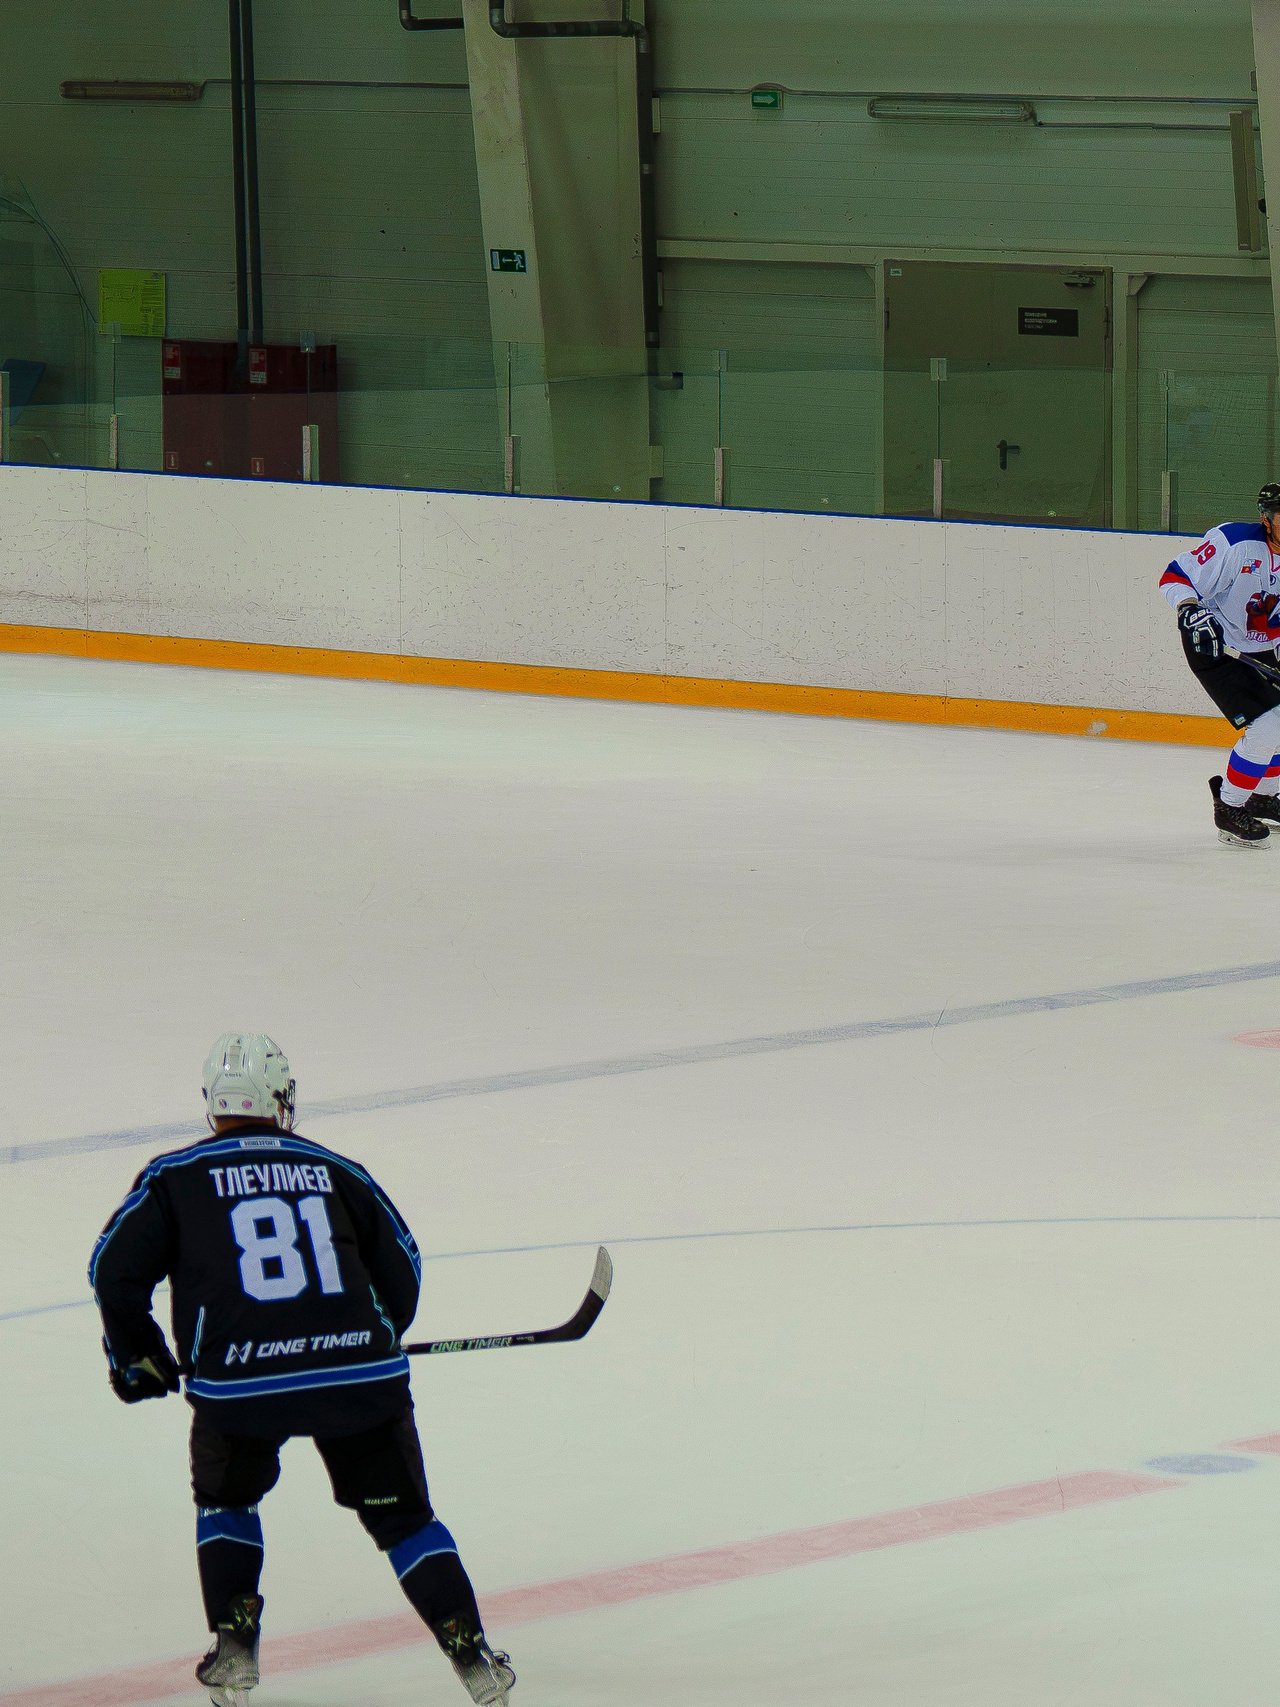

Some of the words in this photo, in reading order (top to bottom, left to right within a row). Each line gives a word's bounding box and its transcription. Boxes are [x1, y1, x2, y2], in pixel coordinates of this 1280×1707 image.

[208, 1163, 333, 1198] ТЛЕУЛИЕВ
[229, 1195, 344, 1302] 81
[255, 1338, 307, 1358] ONE
[310, 1330, 372, 1351] TIMER
[430, 1341, 463, 1353] ONE
[466, 1337, 512, 1351] TIMER
